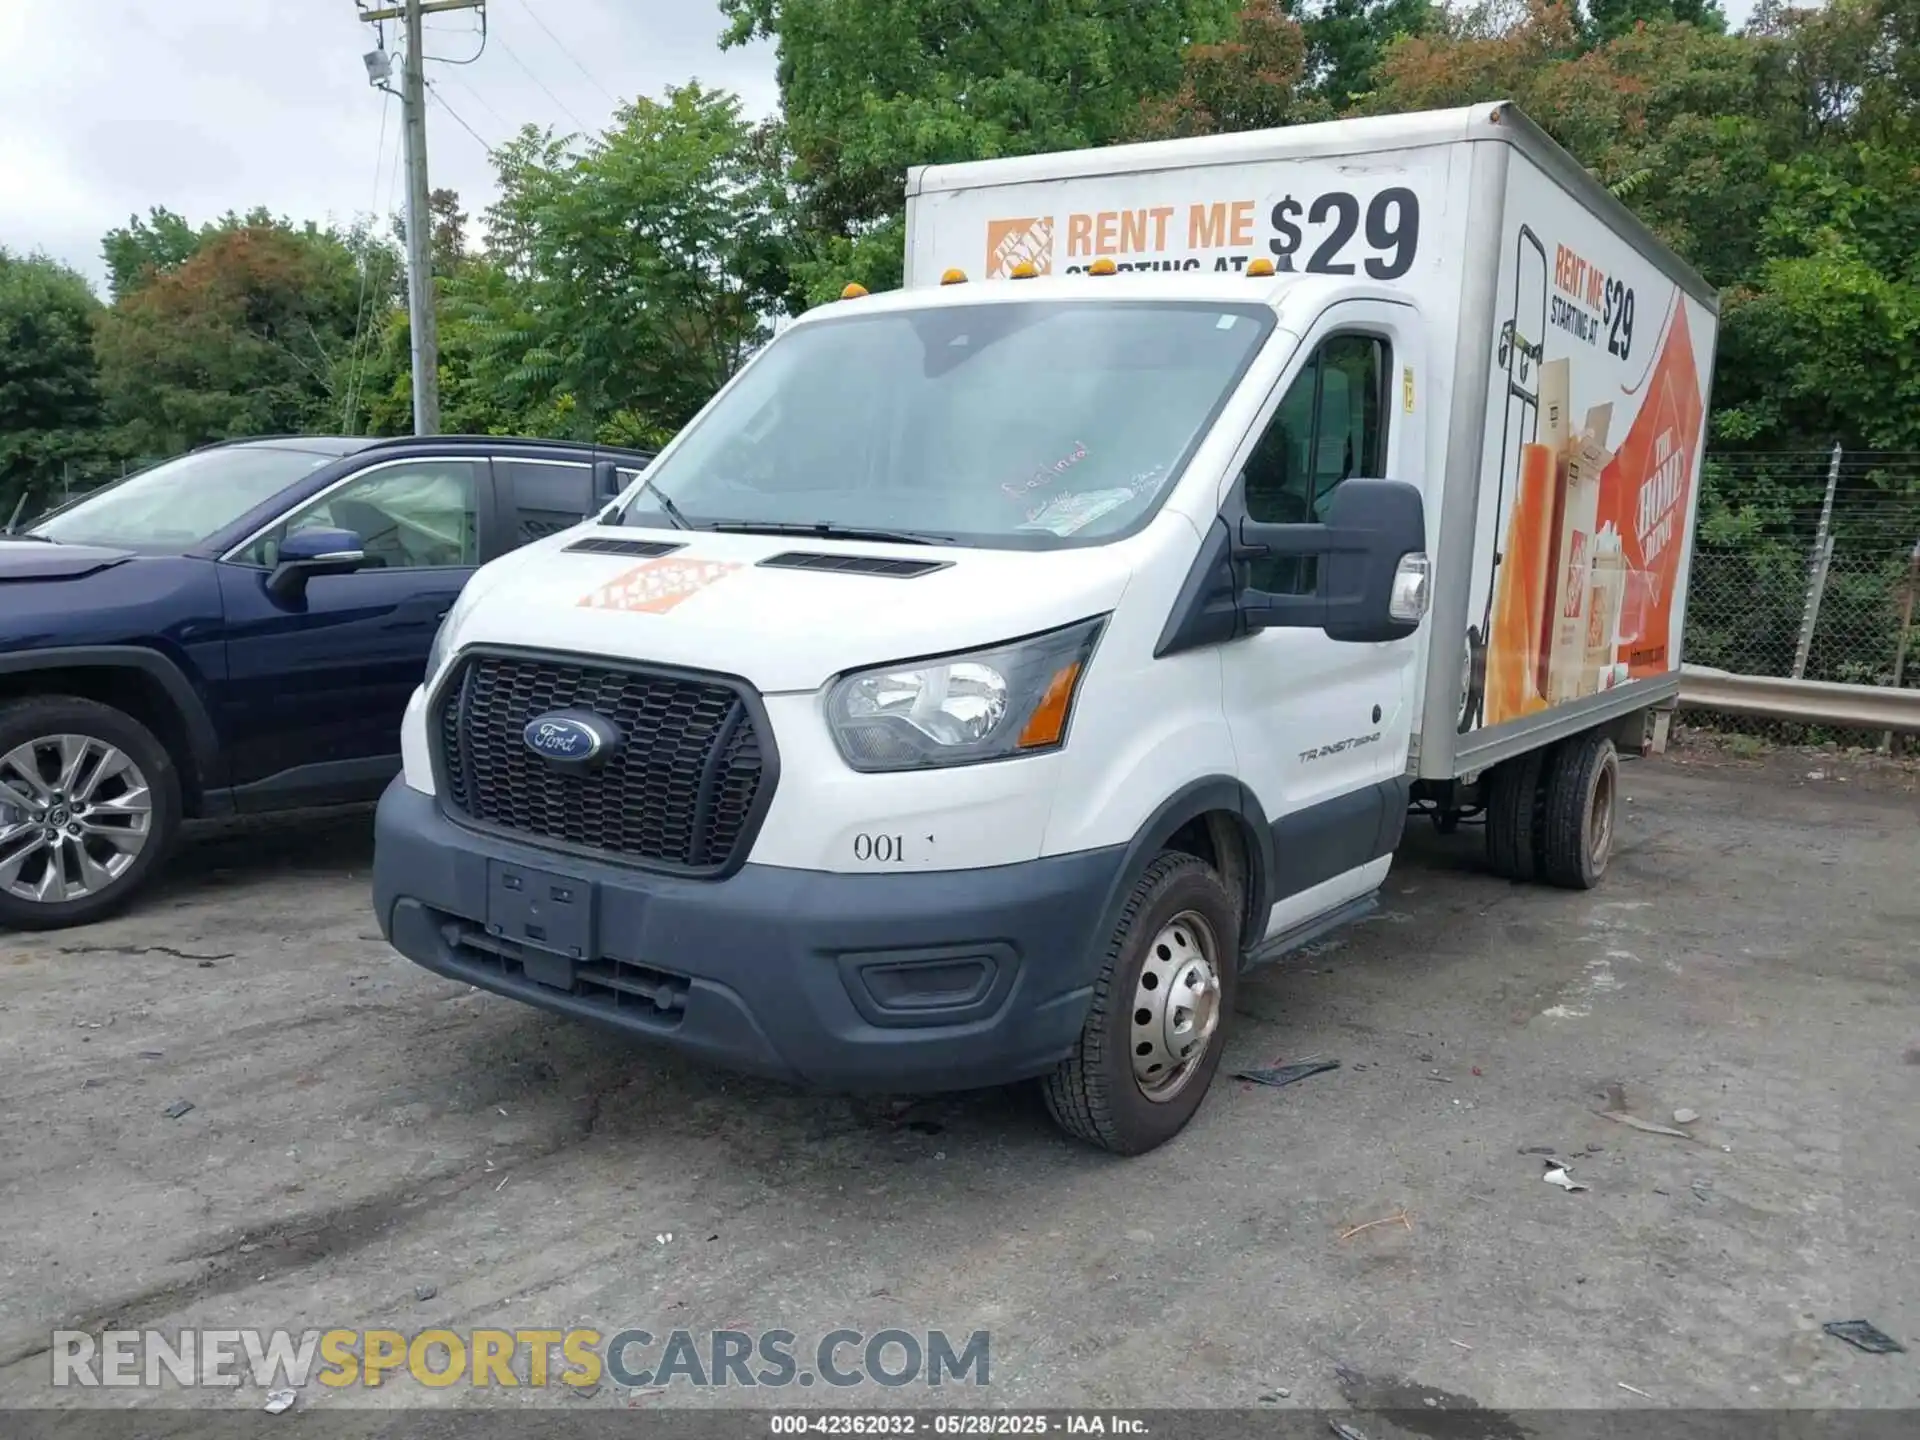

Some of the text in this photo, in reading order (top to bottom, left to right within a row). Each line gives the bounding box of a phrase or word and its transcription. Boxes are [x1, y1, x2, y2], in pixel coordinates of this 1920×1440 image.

[1067, 186, 1419, 280] RENT ME $29
[1551, 294, 1588, 340] STARTING
[1555, 243, 1586, 299] RENT
[1603, 275, 1634, 361] $29
[534, 723, 578, 752] Ford
